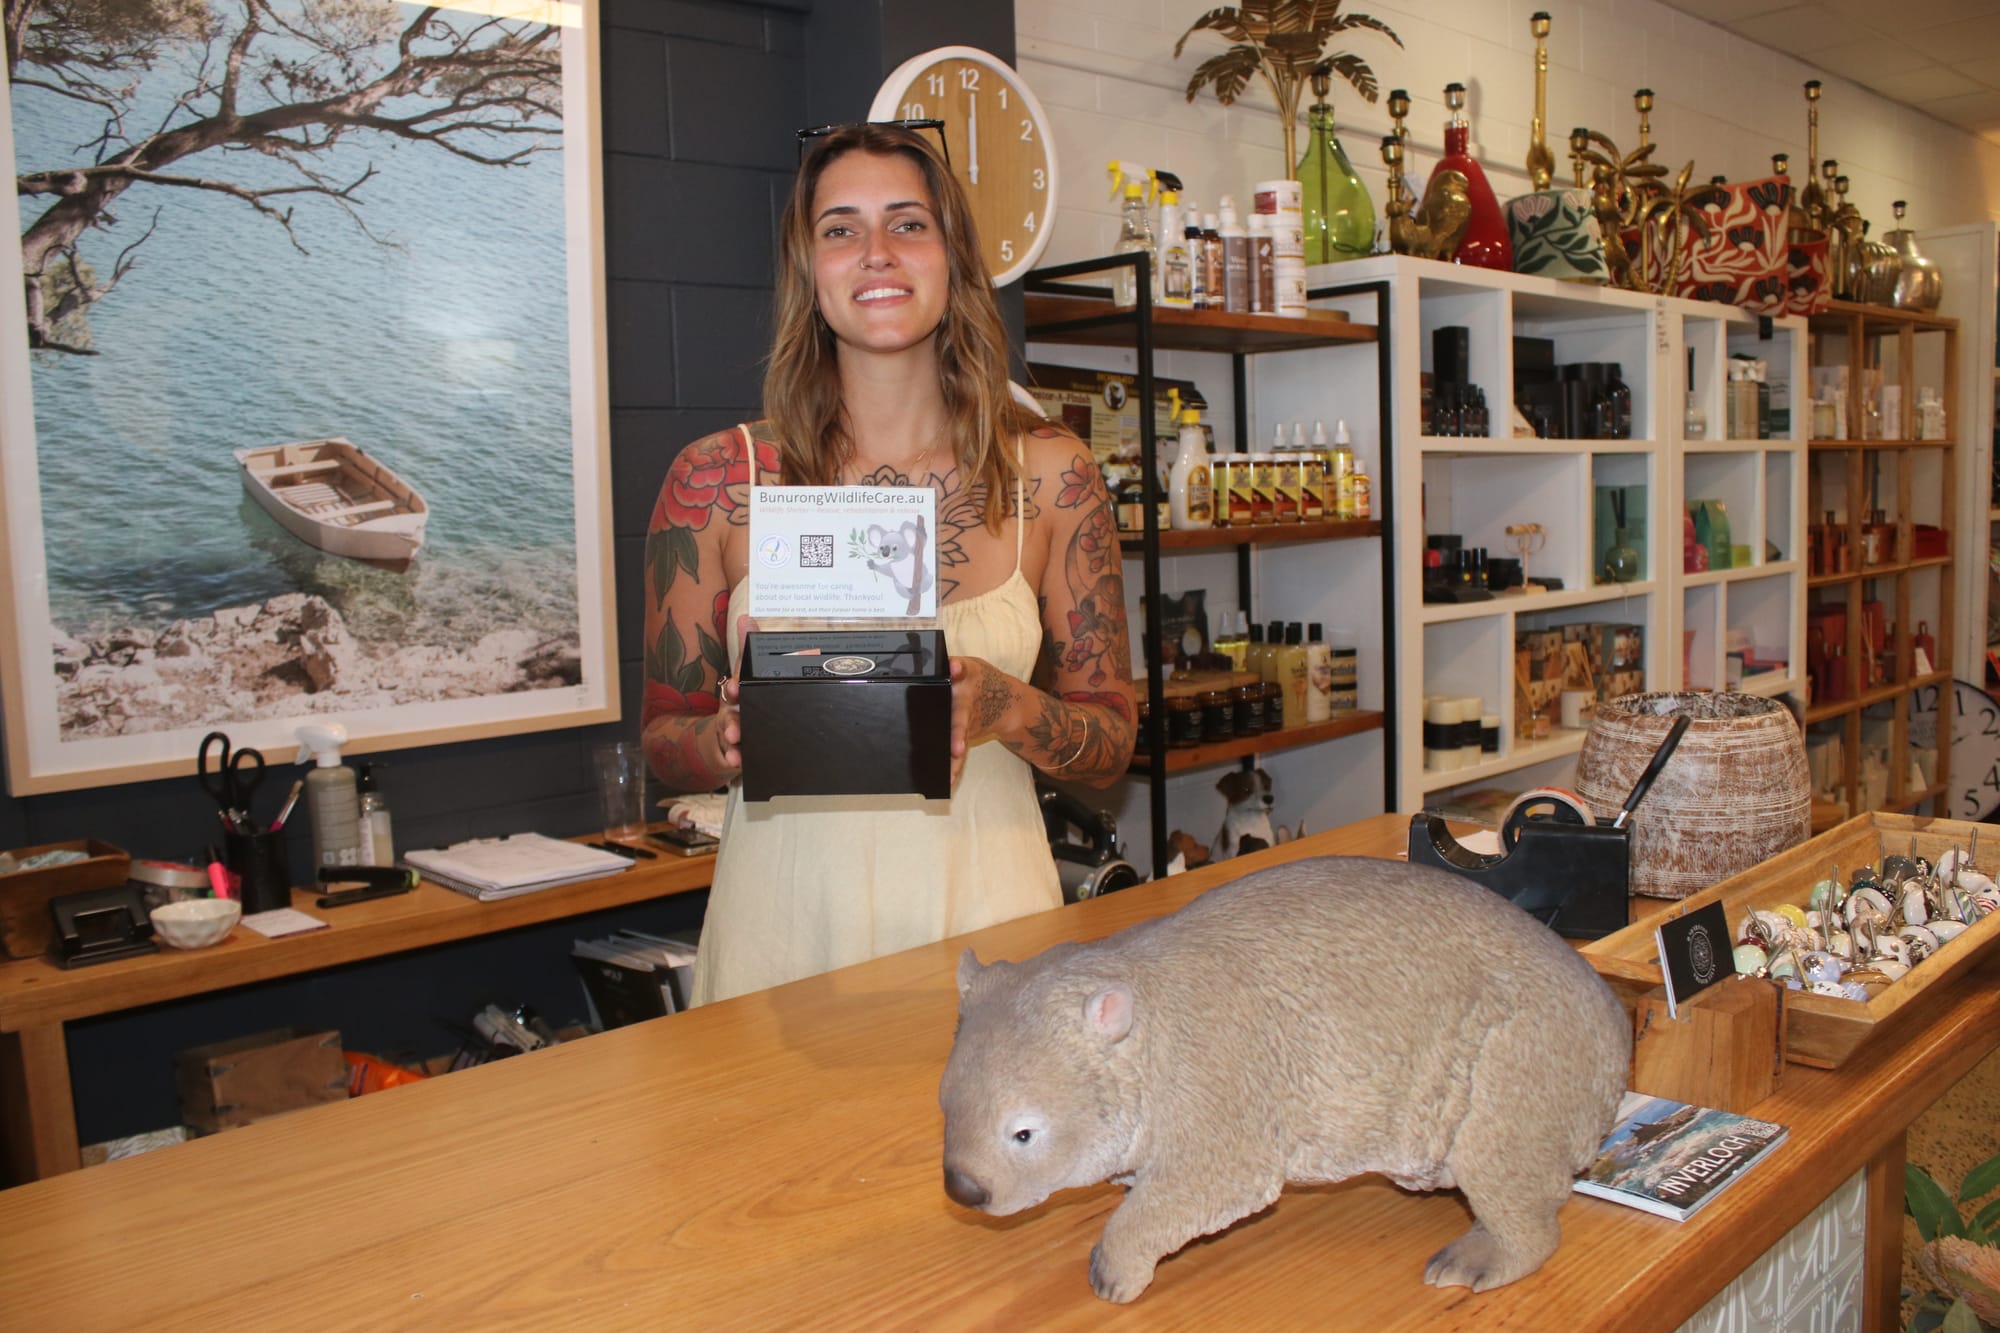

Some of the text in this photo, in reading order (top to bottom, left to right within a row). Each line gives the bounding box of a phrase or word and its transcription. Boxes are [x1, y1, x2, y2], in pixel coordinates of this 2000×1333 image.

[926, 73, 945, 97] 11
[959, 68, 980, 91] 12
[902, 101, 925, 120] 10
[998, 88, 1008, 110] 1
[1020, 119, 1034, 142] 2
[1032, 168, 1046, 190] 3
[1023, 211, 1036, 233] 4
[1000, 240, 1014, 262] 5
[759, 491, 925, 505] BunurongWildlifeCare.au
[1914, 684, 1939, 713] 12
[1955, 689, 1965, 716] 1
[1980, 708, 1999, 736] 2
[1983, 765, 2000, 792] 4
[1964, 789, 1981, 817] 5
[1656, 1134, 1753, 1197] INVERLOCH
